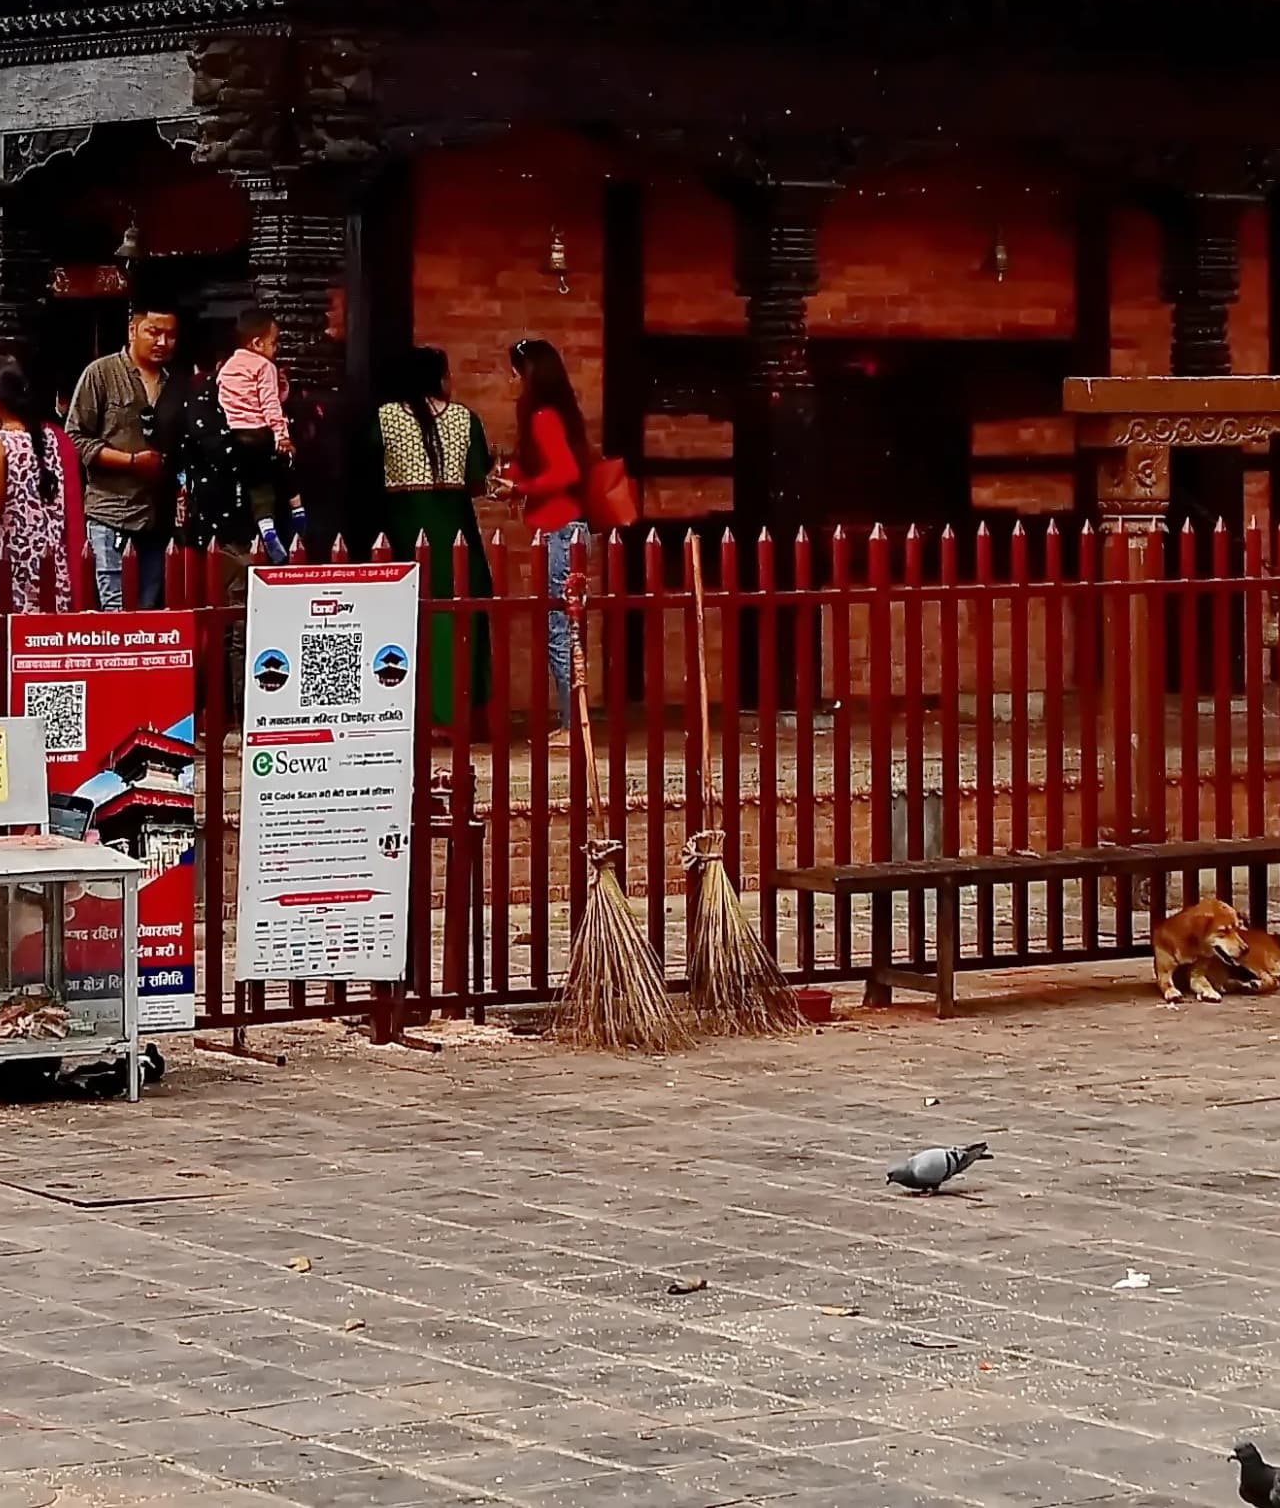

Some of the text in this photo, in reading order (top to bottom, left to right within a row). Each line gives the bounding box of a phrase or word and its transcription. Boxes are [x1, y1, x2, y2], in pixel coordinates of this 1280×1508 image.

[67, 630, 120, 646] Mobile
[124, 629, 155, 647] प्रयोग
[158, 629, 180, 645] गरी
[274, 790, 296, 801] Code
[298, 788, 318, 799] Scan
[148, 971, 184, 987] समिति
